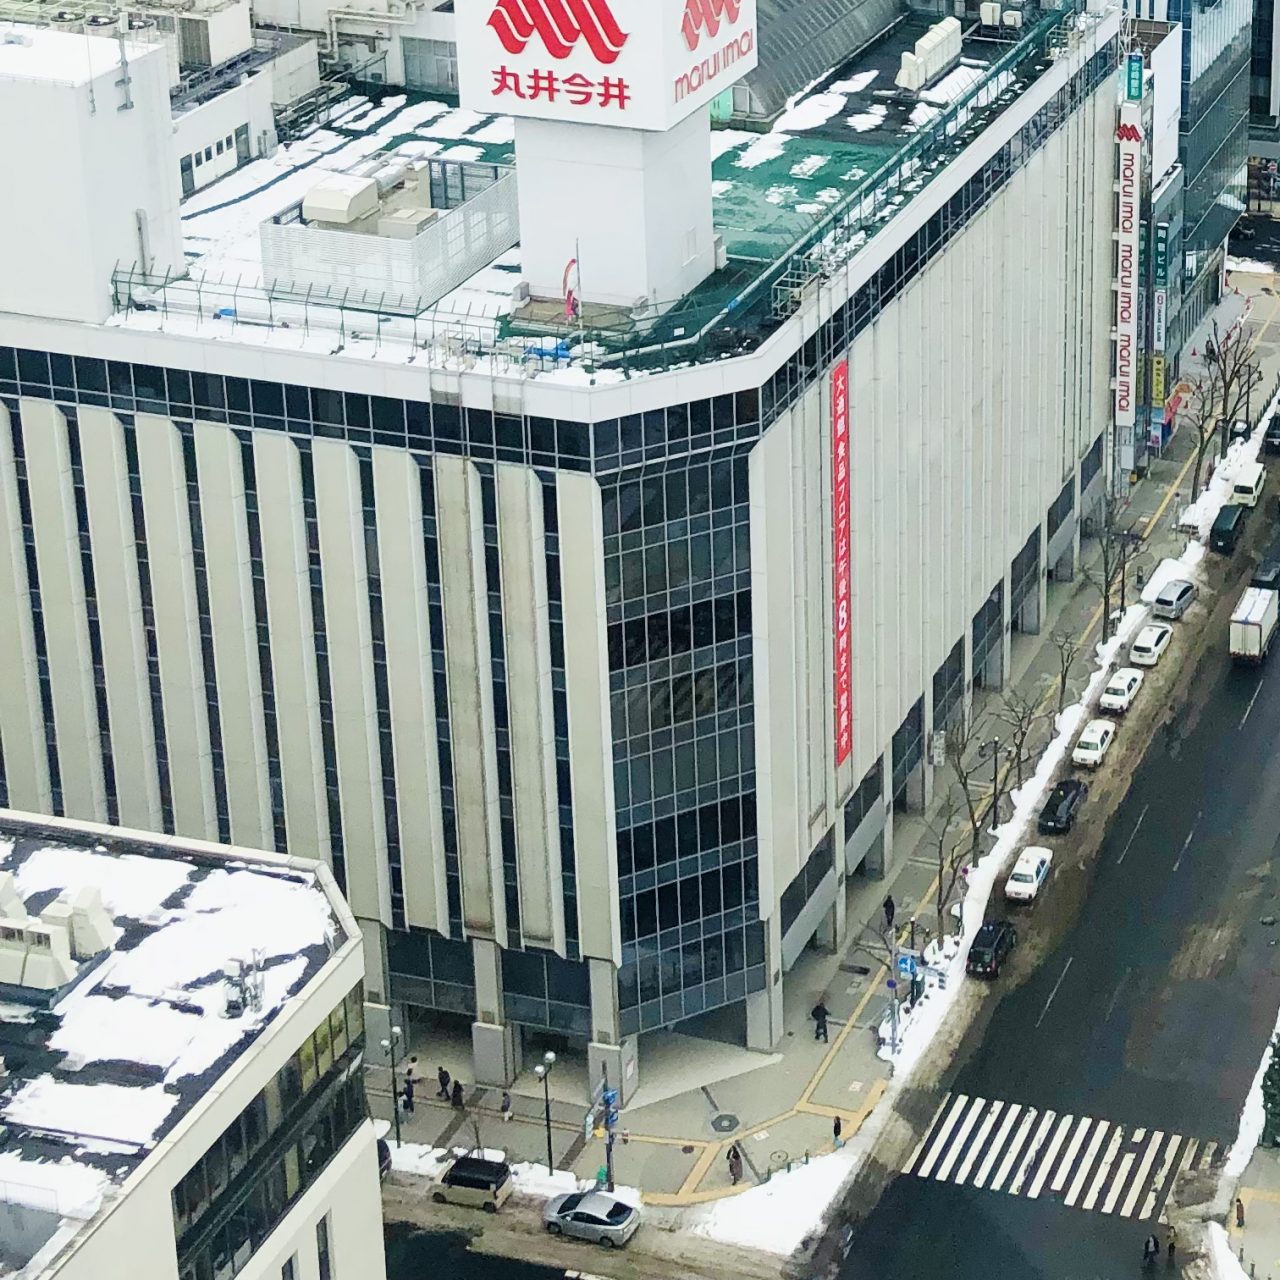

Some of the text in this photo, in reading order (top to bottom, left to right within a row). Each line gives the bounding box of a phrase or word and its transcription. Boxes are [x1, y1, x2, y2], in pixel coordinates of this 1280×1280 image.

[490, 64, 631, 110] 丸井今井
[674, 52, 721, 103] marui
[1122, 152, 1135, 198] marui
[1120, 244, 1133, 289] marui
[1118, 333, 1131, 378] marui
